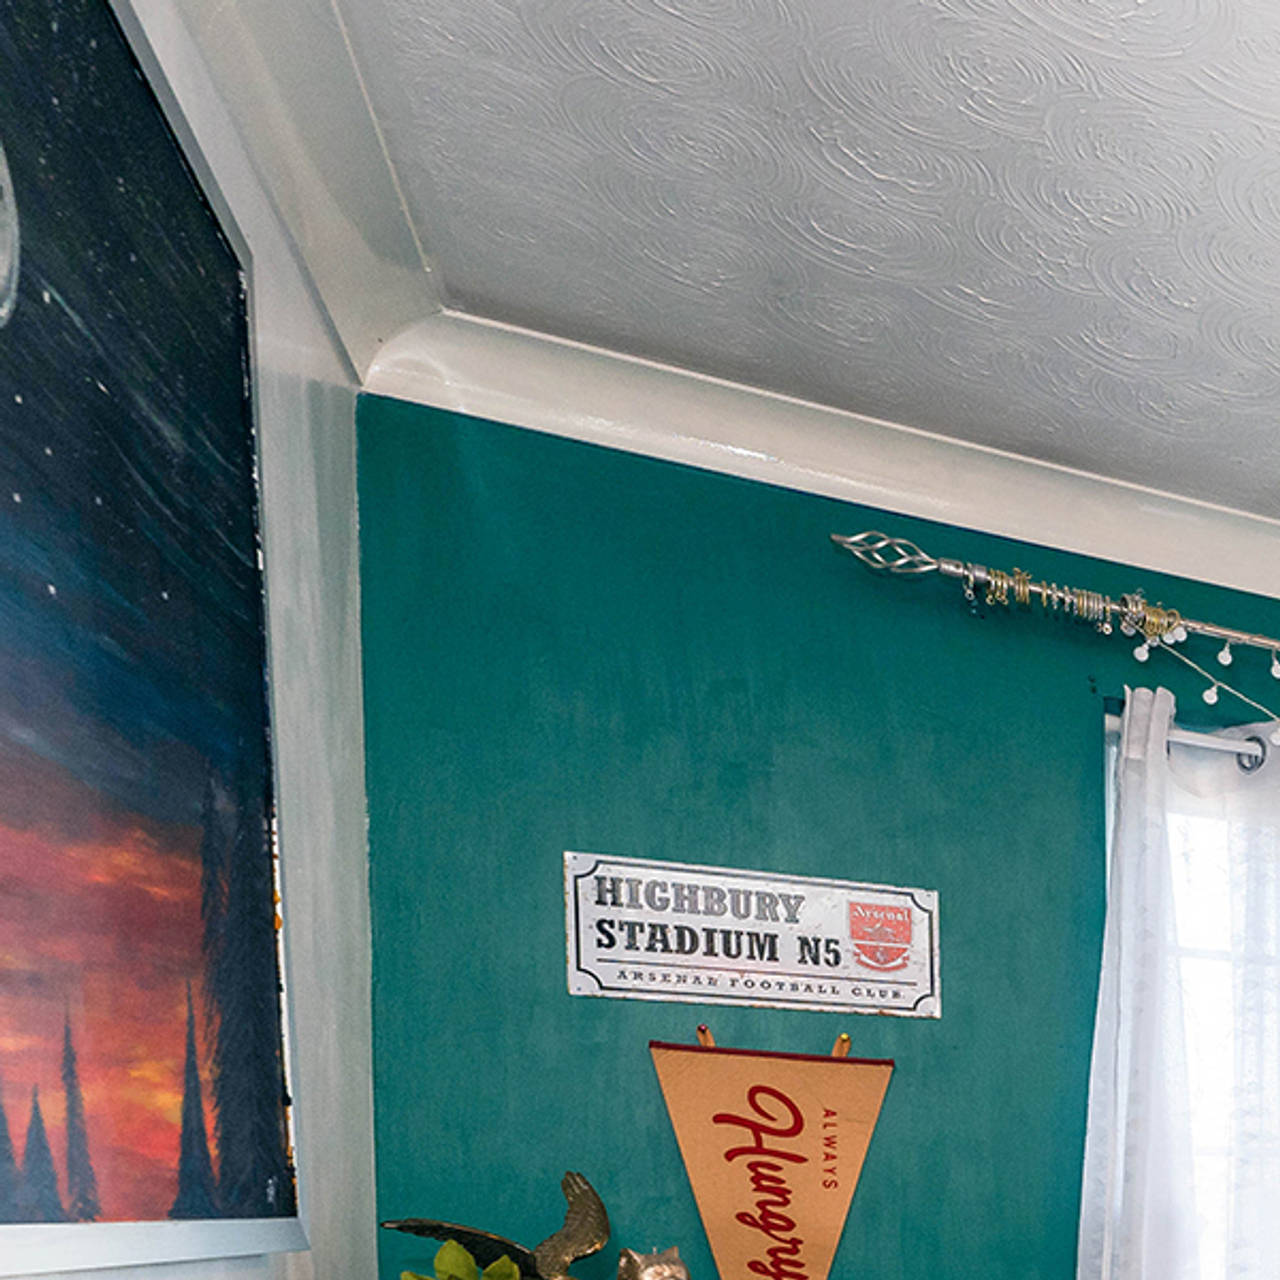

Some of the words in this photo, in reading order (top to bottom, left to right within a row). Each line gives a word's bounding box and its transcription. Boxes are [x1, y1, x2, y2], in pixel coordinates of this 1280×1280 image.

[594, 875, 805, 924] HIGHBURY
[852, 905, 910, 921] Arsenal
[595, 918, 780, 962] STADIUM
[797, 936, 842, 967] N5
[616, 970, 719, 987] ARSENAL
[730, 976, 841, 996] FOOTBALL
[822, 1108, 838, 1190] ALWAYS
